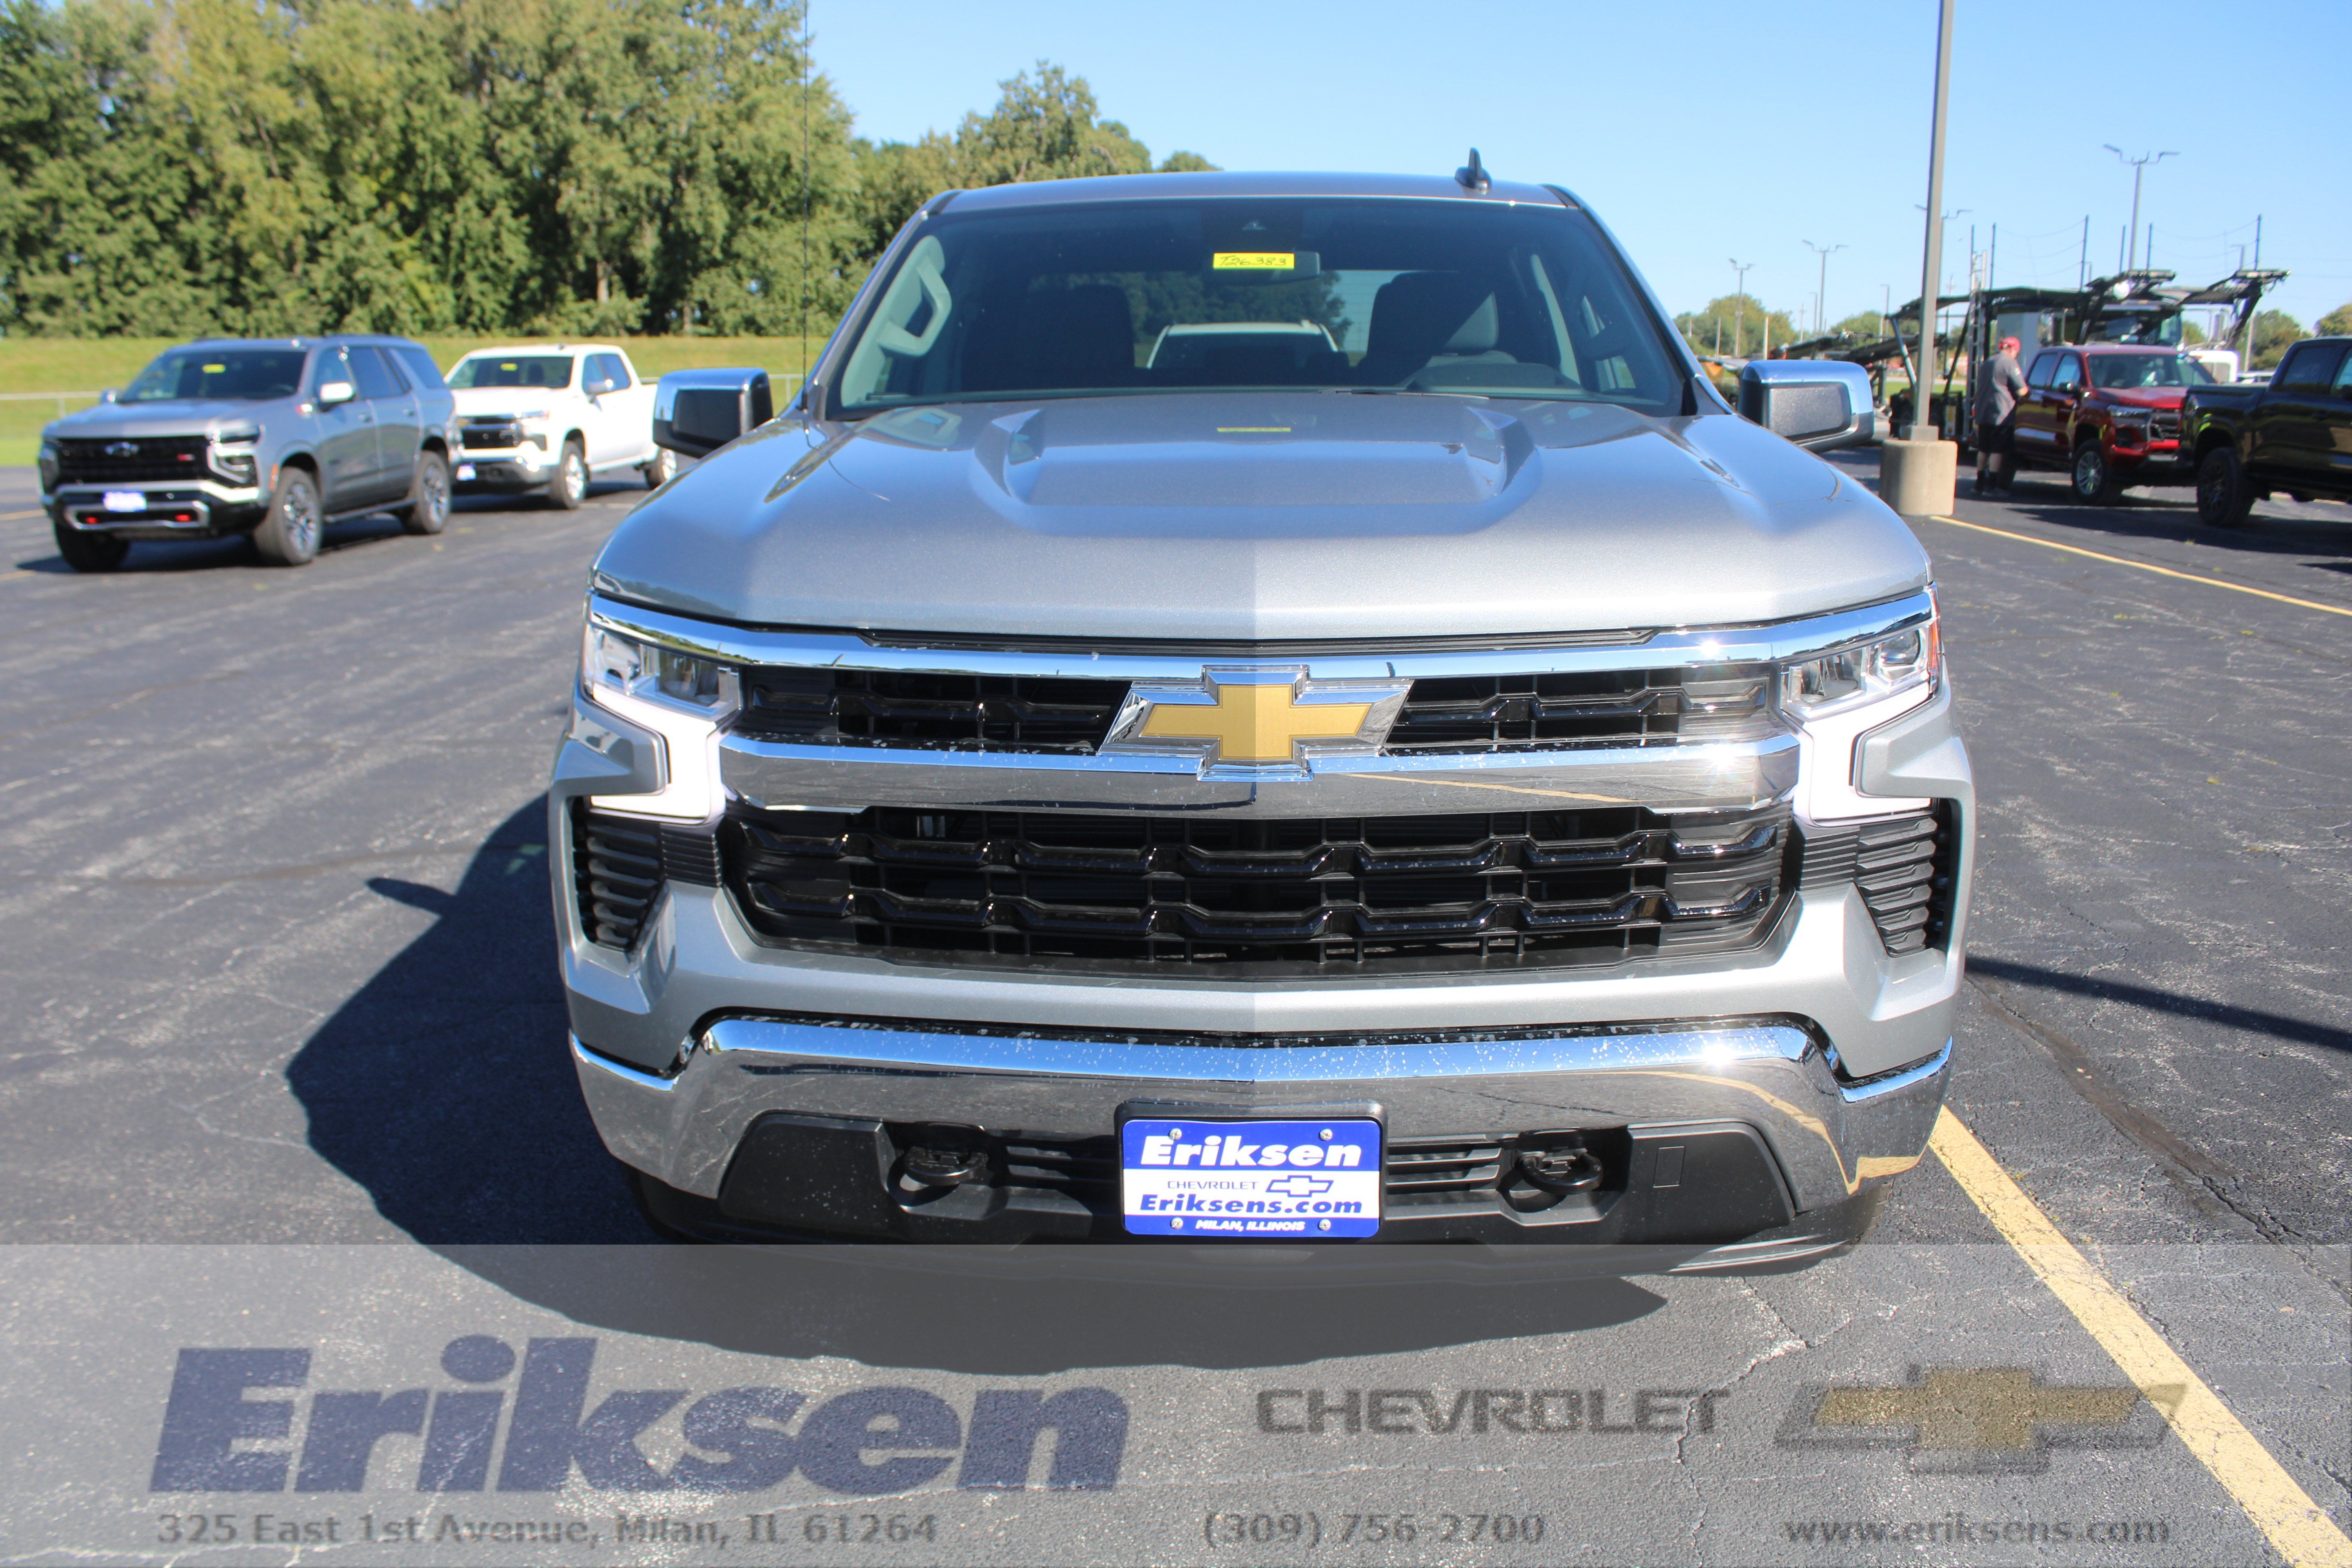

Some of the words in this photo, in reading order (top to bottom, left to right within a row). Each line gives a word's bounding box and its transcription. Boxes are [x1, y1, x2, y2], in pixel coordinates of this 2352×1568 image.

[1219, 255, 1287, 267] T26383
[1140, 1135, 1362, 1167] Eriksen
[1167, 1180, 1259, 1190] CHEVROLET
[1140, 1194, 1362, 1214] Eriksens.com
[1195, 1220, 1244, 1232] MILAN,
[1246, 1221, 1306, 1231] ILLINOIS
